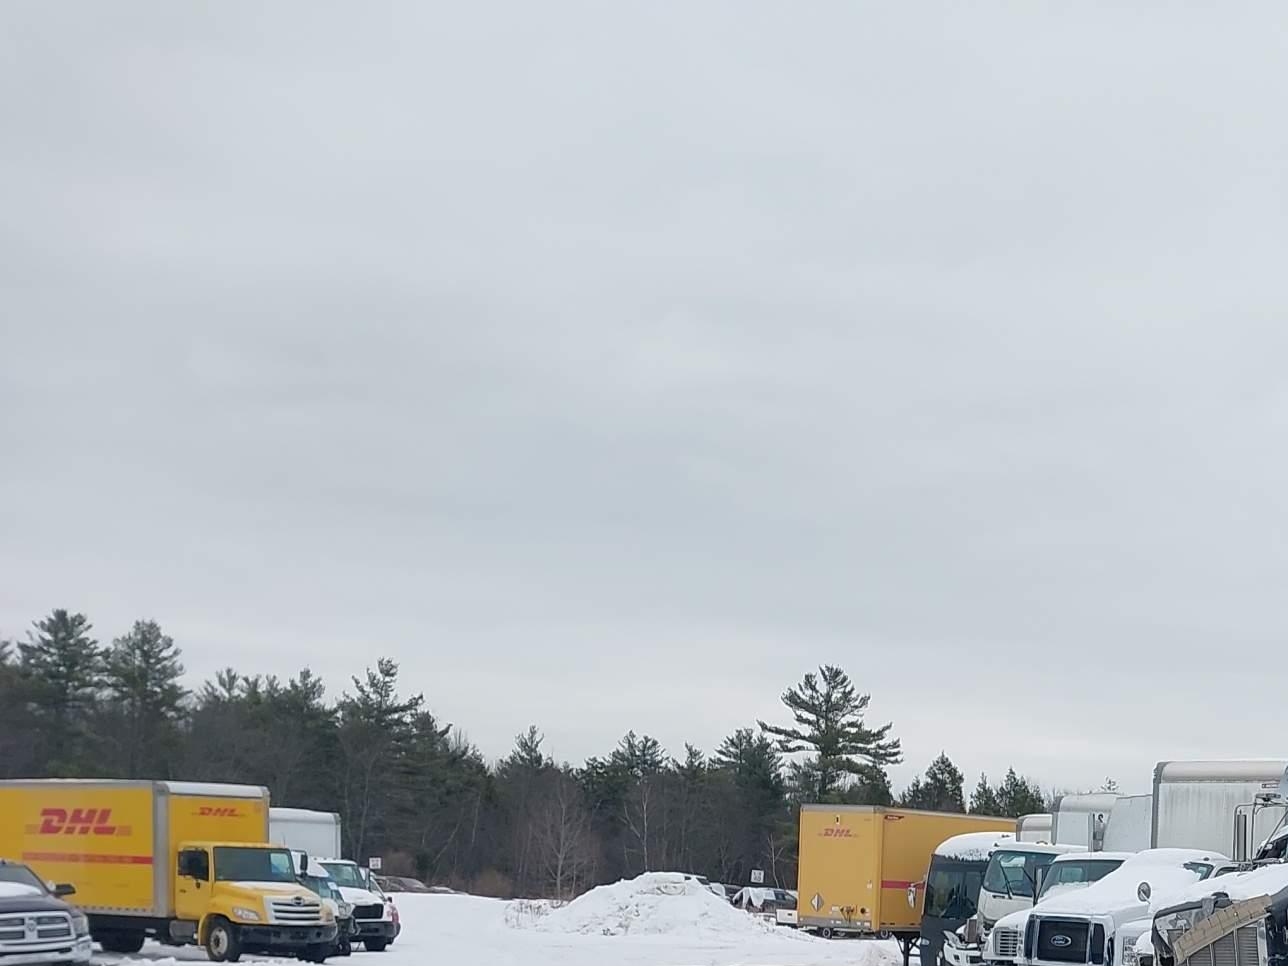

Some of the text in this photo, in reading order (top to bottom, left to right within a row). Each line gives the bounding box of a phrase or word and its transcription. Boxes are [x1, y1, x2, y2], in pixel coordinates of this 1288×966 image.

[199, 806, 239, 817] DHL
[39, 808, 116, 835] DHL
[823, 828, 853, 838] DHL
